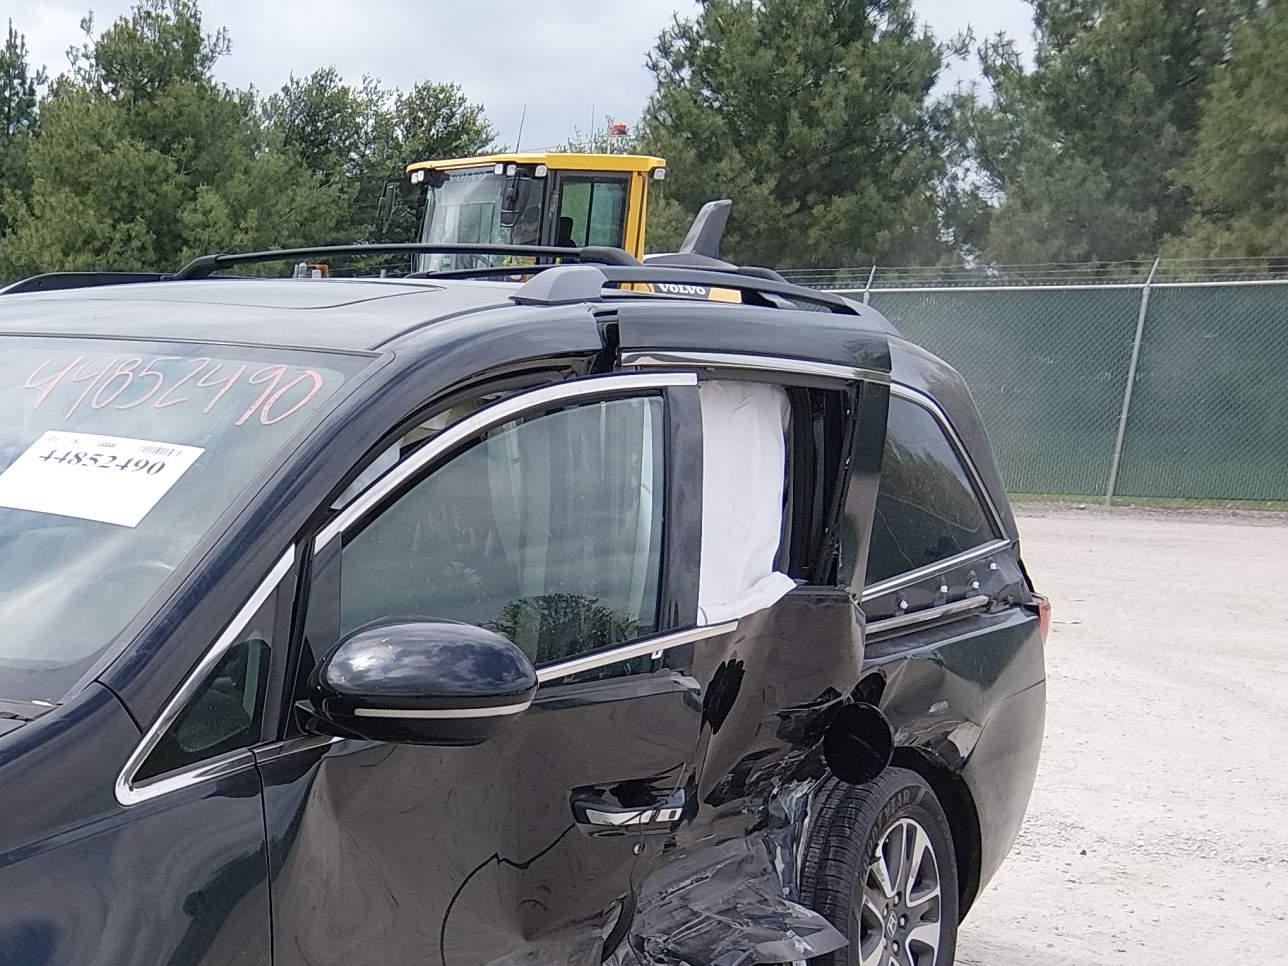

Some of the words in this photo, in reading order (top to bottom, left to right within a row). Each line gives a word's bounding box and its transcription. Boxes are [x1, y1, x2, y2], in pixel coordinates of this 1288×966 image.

[658, 283, 705, 295] VOLVO
[24, 355, 325, 426] 44852490
[38, 448, 167, 476] 44852490
